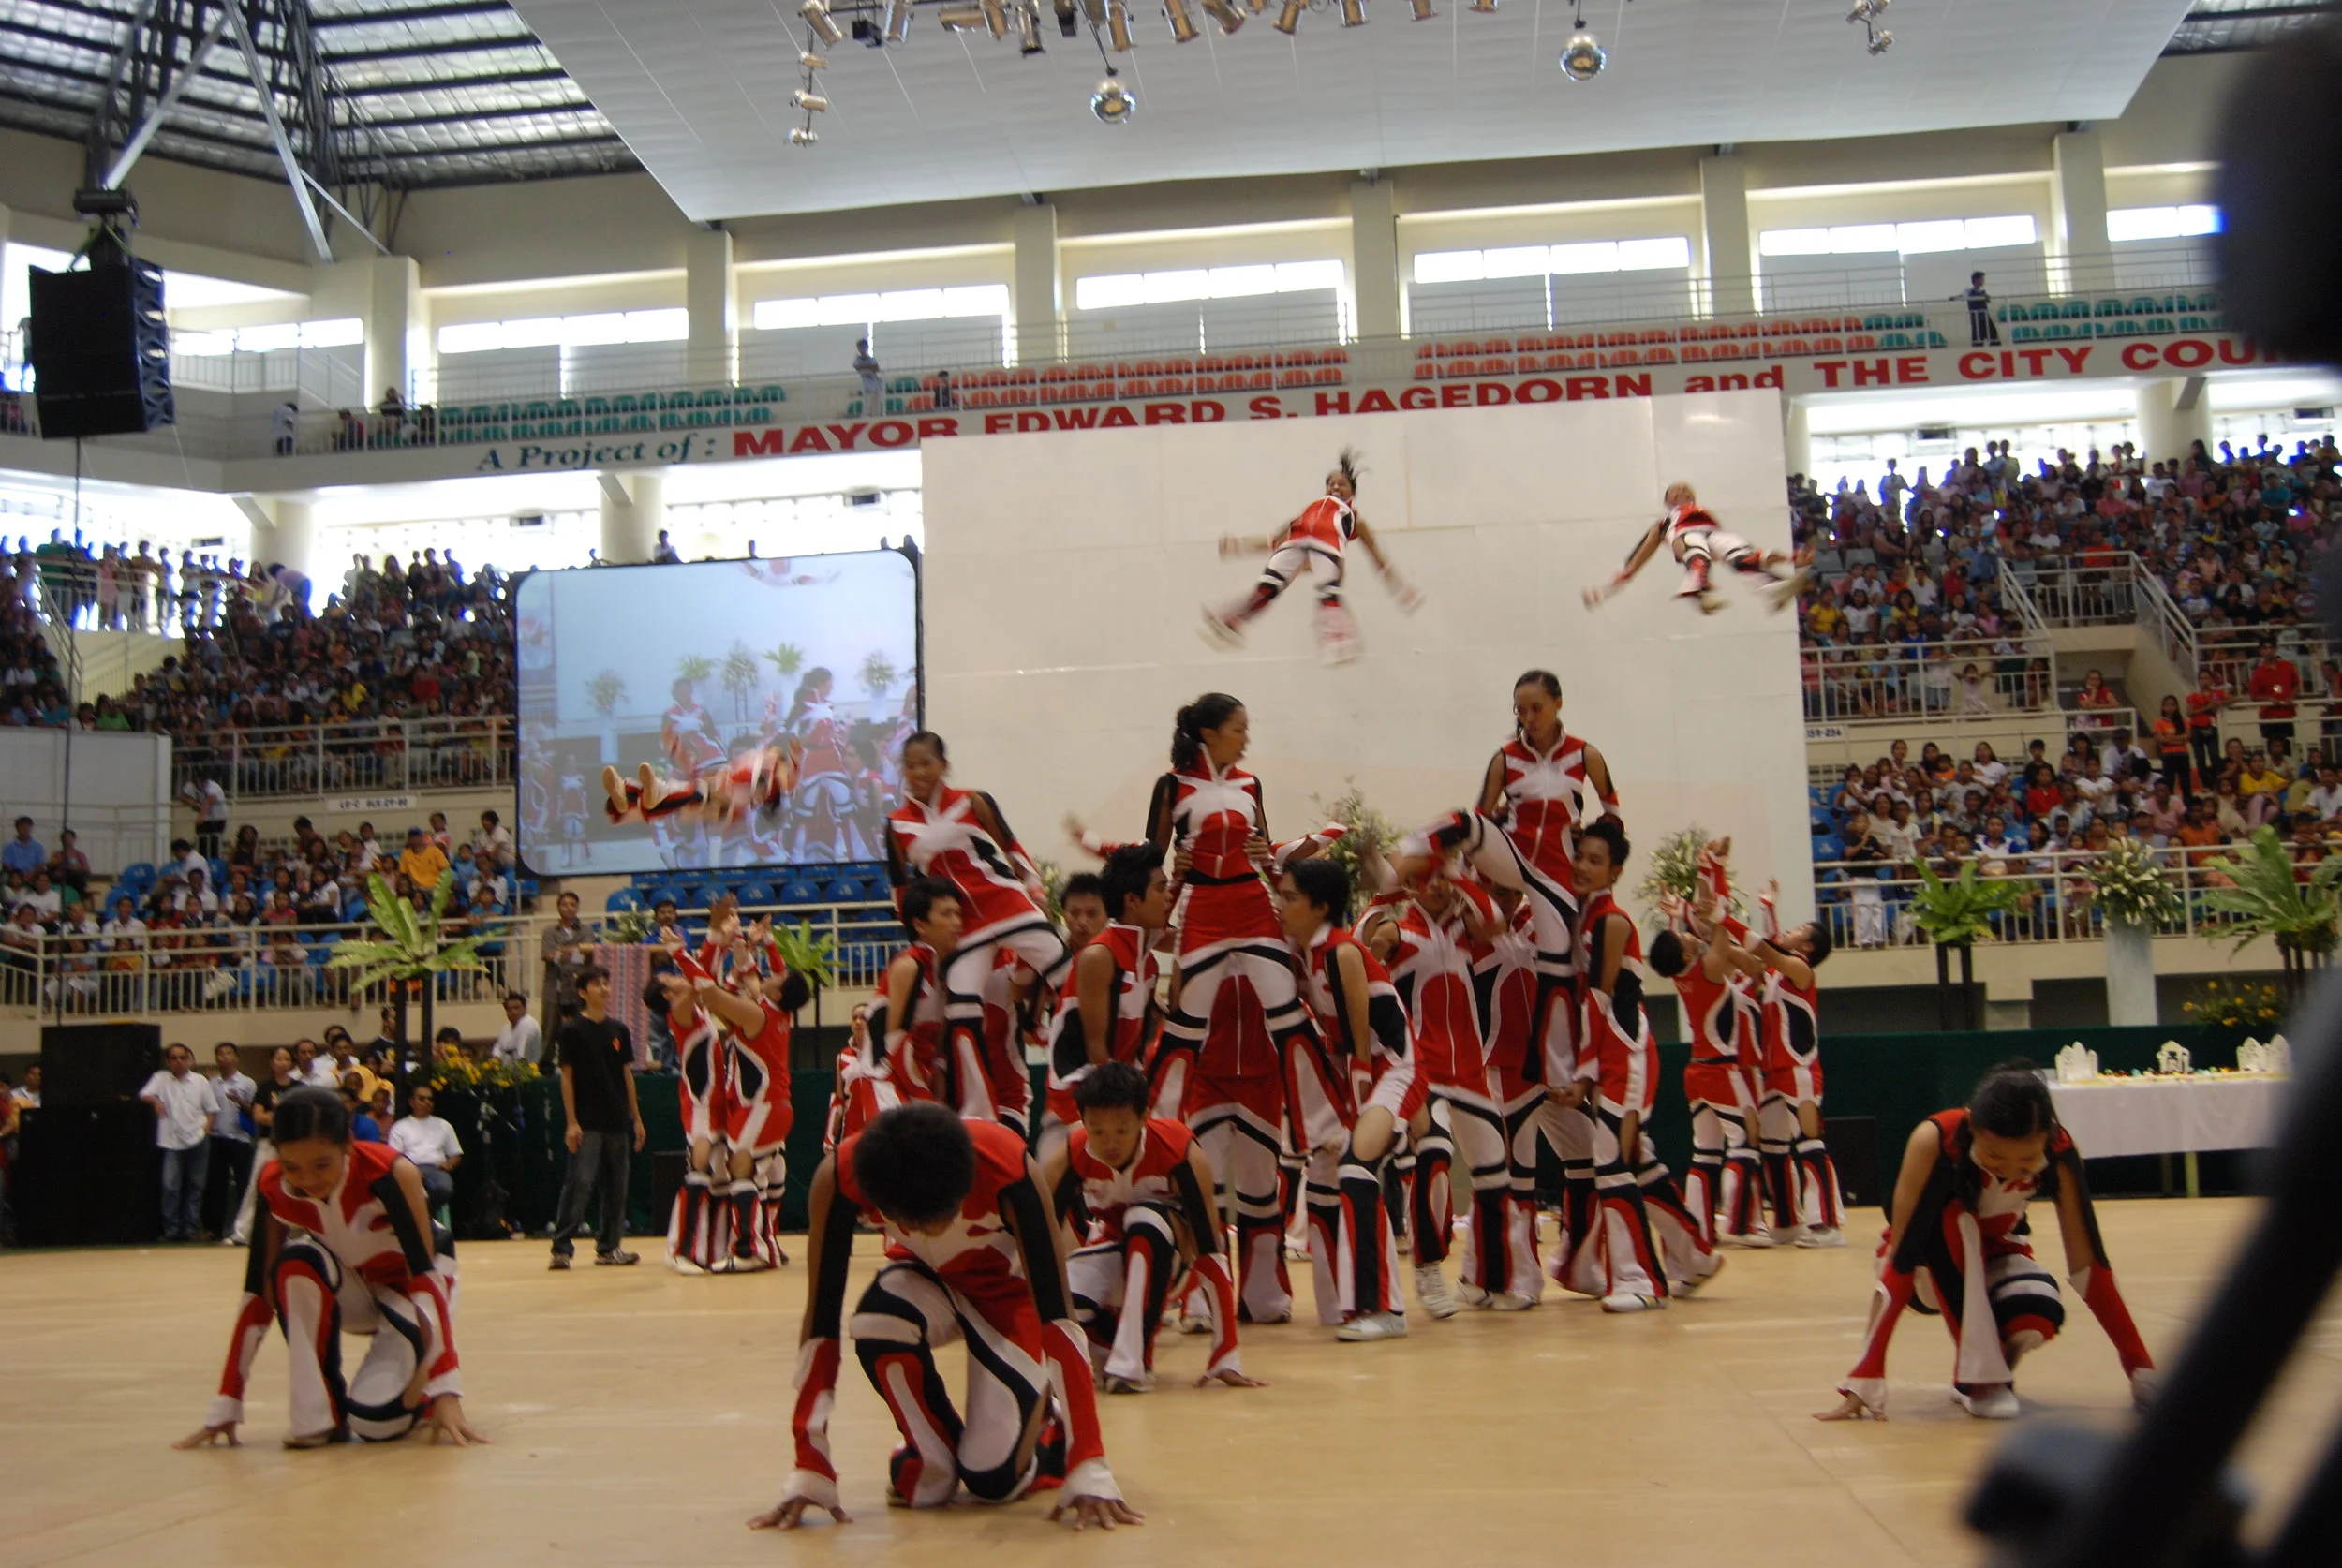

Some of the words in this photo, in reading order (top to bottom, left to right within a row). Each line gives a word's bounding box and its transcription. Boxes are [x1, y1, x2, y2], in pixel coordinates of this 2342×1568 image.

[476, 449, 503, 471] A
[517, 441, 645, 470] Project
[734, 417, 959, 457] MAYOR
[985, 400, 1225, 435] EDWARD
[1248, 395, 1298, 420] S.
[1314, 373, 1653, 417] HAGEDORN
[1683, 364, 1784, 393] and
[1814, 356, 1930, 388] THE
[1958, 346, 2093, 379] CITY
